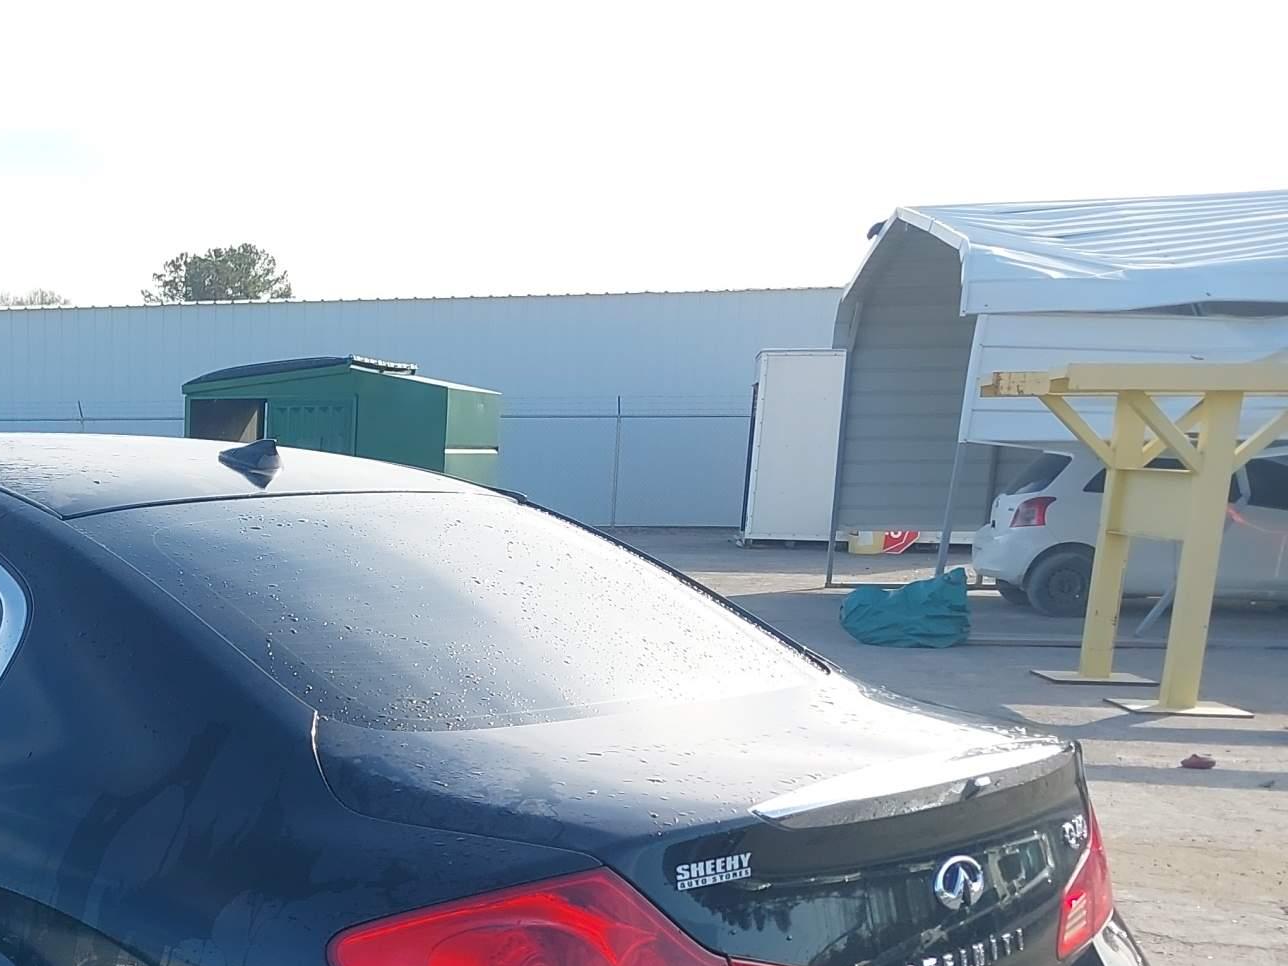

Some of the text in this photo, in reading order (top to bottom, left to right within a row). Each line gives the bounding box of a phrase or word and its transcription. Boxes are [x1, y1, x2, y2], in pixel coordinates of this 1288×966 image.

[676, 853, 752, 880] SHEEHY
[679, 869, 749, 889] AUTO STORES
